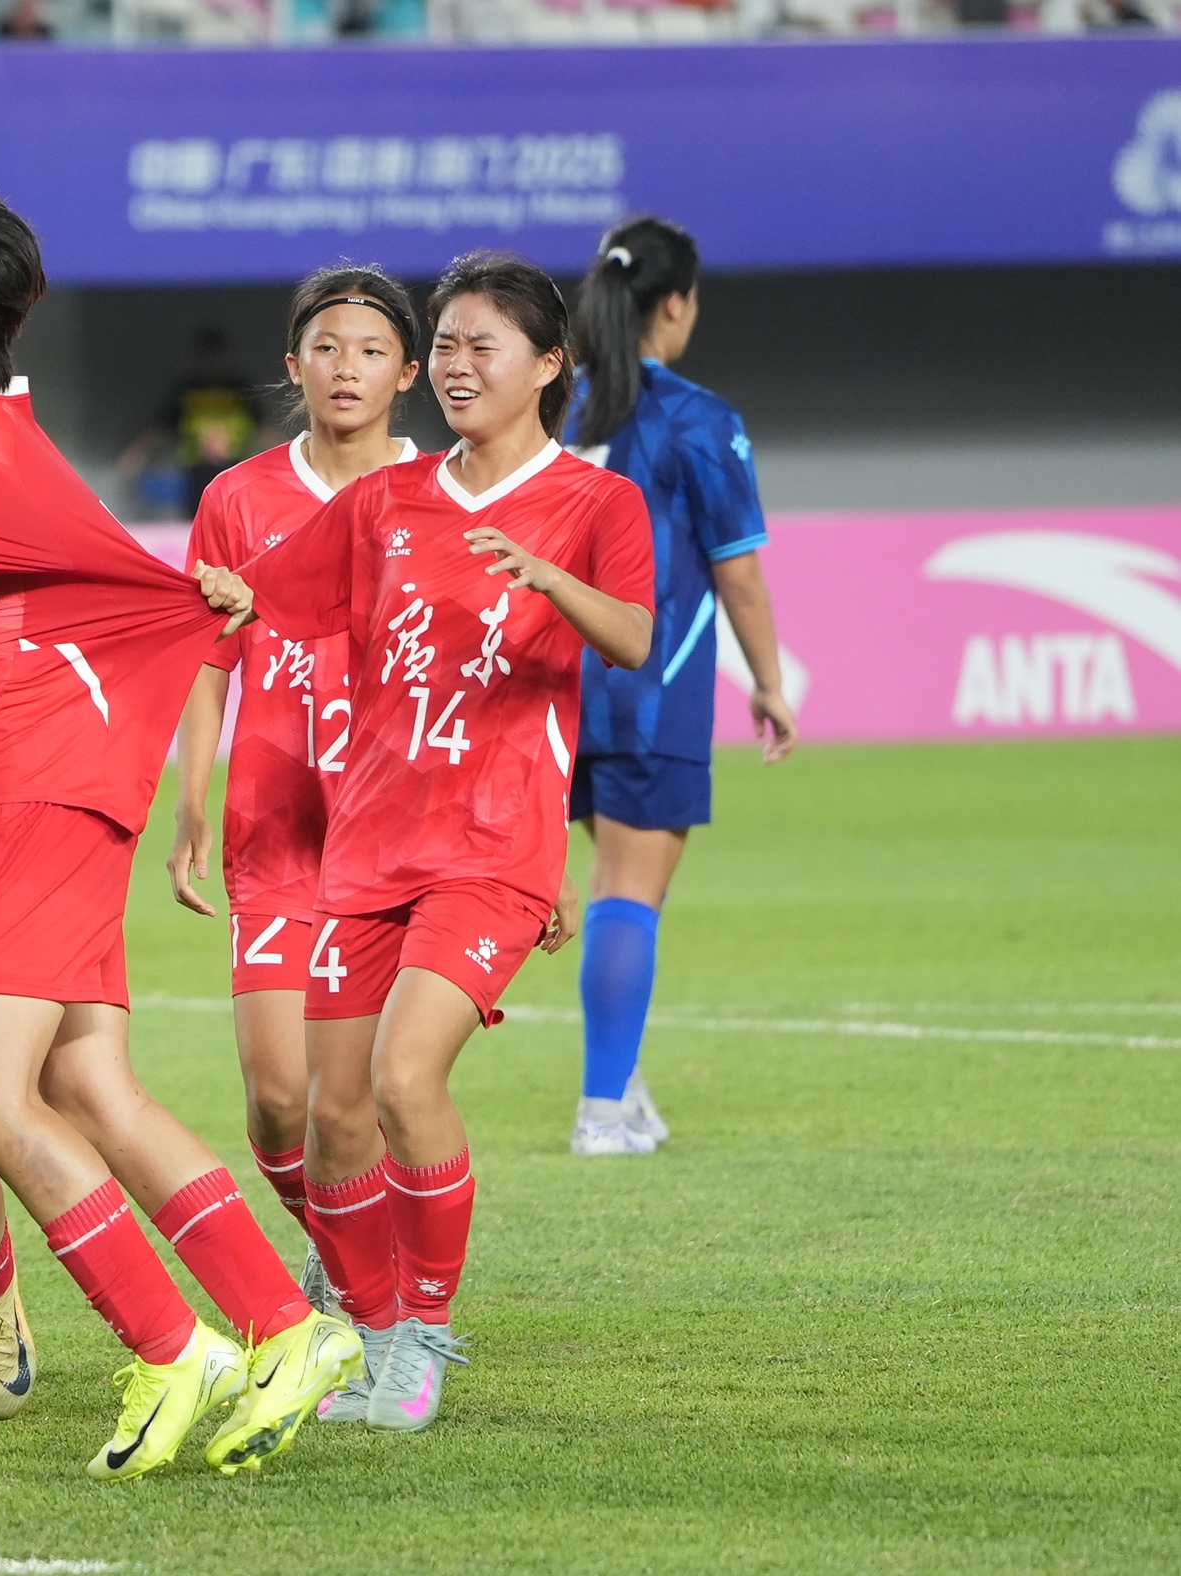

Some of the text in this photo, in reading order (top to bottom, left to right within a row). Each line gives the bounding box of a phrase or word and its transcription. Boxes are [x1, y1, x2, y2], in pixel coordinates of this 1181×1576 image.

[951, 633, 1137, 725] ANTA
[302, 694, 351, 772] 12
[408, 686, 470, 765] 14
